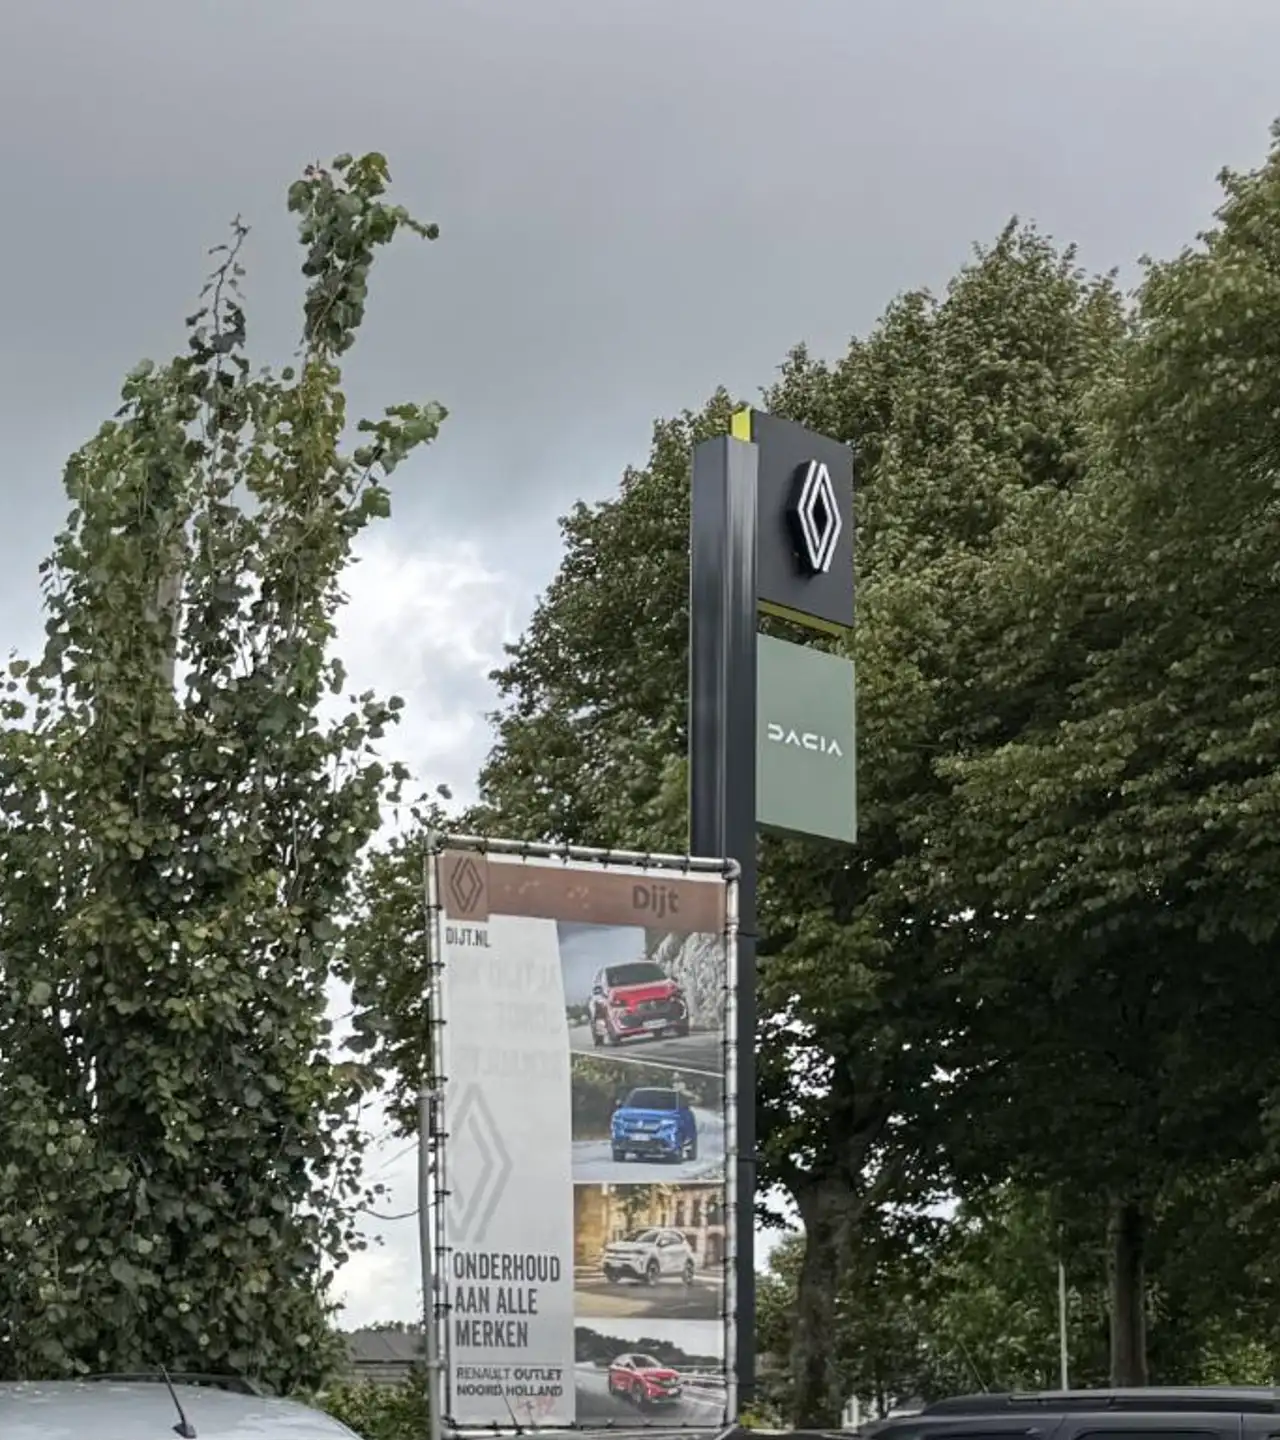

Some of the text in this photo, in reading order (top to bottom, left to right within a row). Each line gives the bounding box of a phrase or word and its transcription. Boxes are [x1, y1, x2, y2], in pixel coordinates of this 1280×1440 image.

[767, 723, 843, 757] DACIA
[633, 884, 679, 919] Dijt
[445, 926, 491, 949] DIJT.NL
[453, 1252, 560, 1282] ONDERHOUD
[455, 1286, 539, 1315] AAN ALLE
[455, 1320, 528, 1348] MERKEN
[457, 1367, 562, 1381] RENAULT OUTLET
[457, 1383, 562, 1397] NOORD HOLLAND
